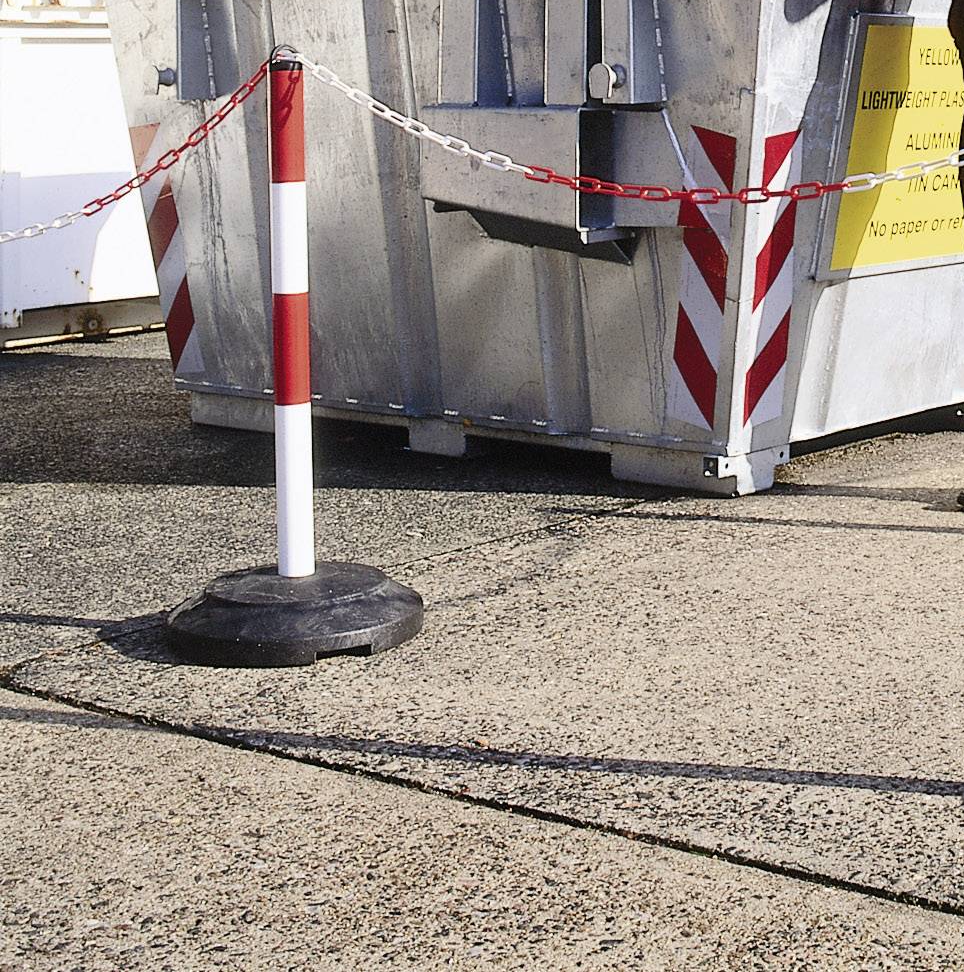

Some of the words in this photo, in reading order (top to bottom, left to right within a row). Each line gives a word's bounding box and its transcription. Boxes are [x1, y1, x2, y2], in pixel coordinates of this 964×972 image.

[861, 90, 938, 110] LIGHTWEIGHT
[868, 220, 887, 237] No
[890, 218, 928, 241] paper
[931, 218, 945, 231] or
